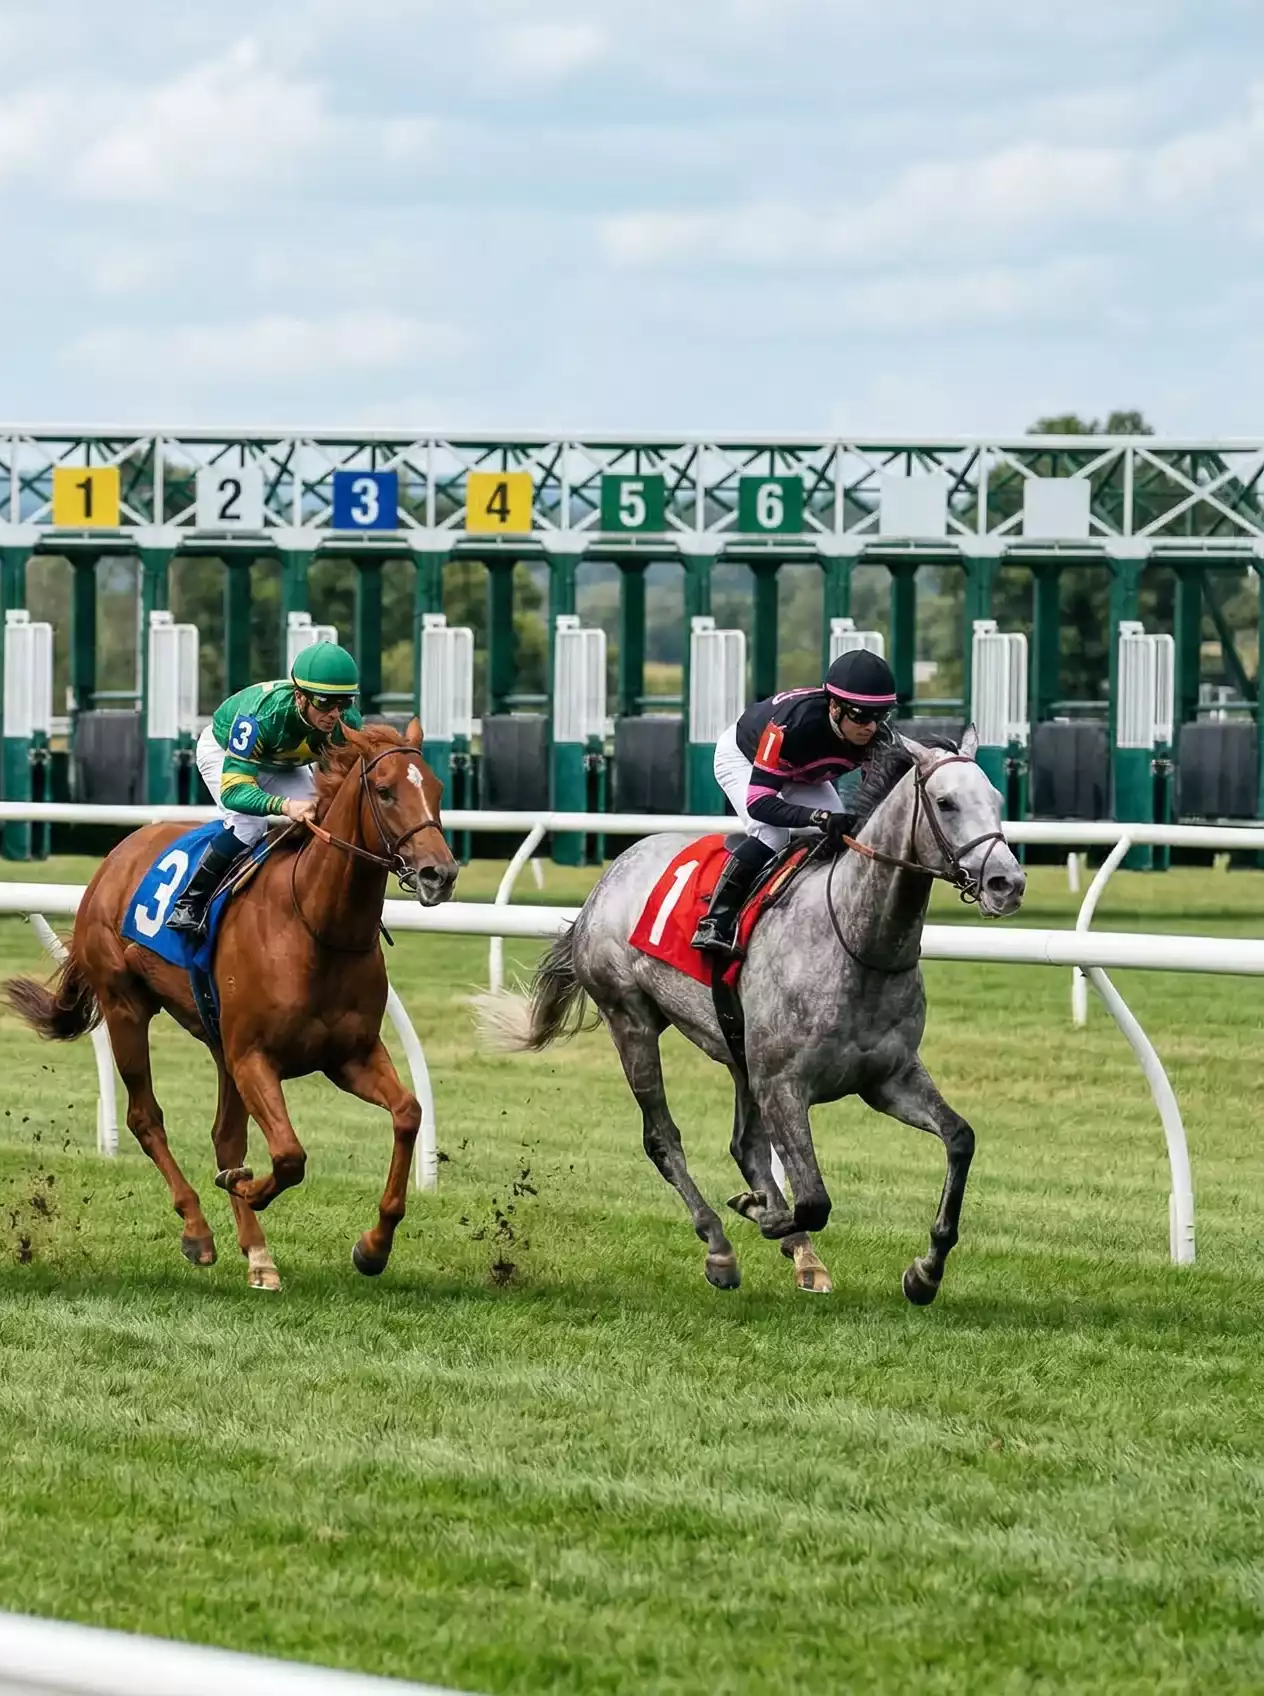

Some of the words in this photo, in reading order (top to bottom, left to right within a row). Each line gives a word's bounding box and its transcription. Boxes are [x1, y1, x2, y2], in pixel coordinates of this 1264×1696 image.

[75, 478, 94, 519] 1
[218, 478, 242, 520] 2
[351, 479, 378, 524] 3
[486, 483, 511, 523] 4
[619, 483, 645, 527] 5
[757, 483, 783, 528] 6
[232, 721, 253, 751] 3
[763, 732, 776, 761] 1
[134, 849, 189, 938] 3
[648, 860, 700, 946] 1
